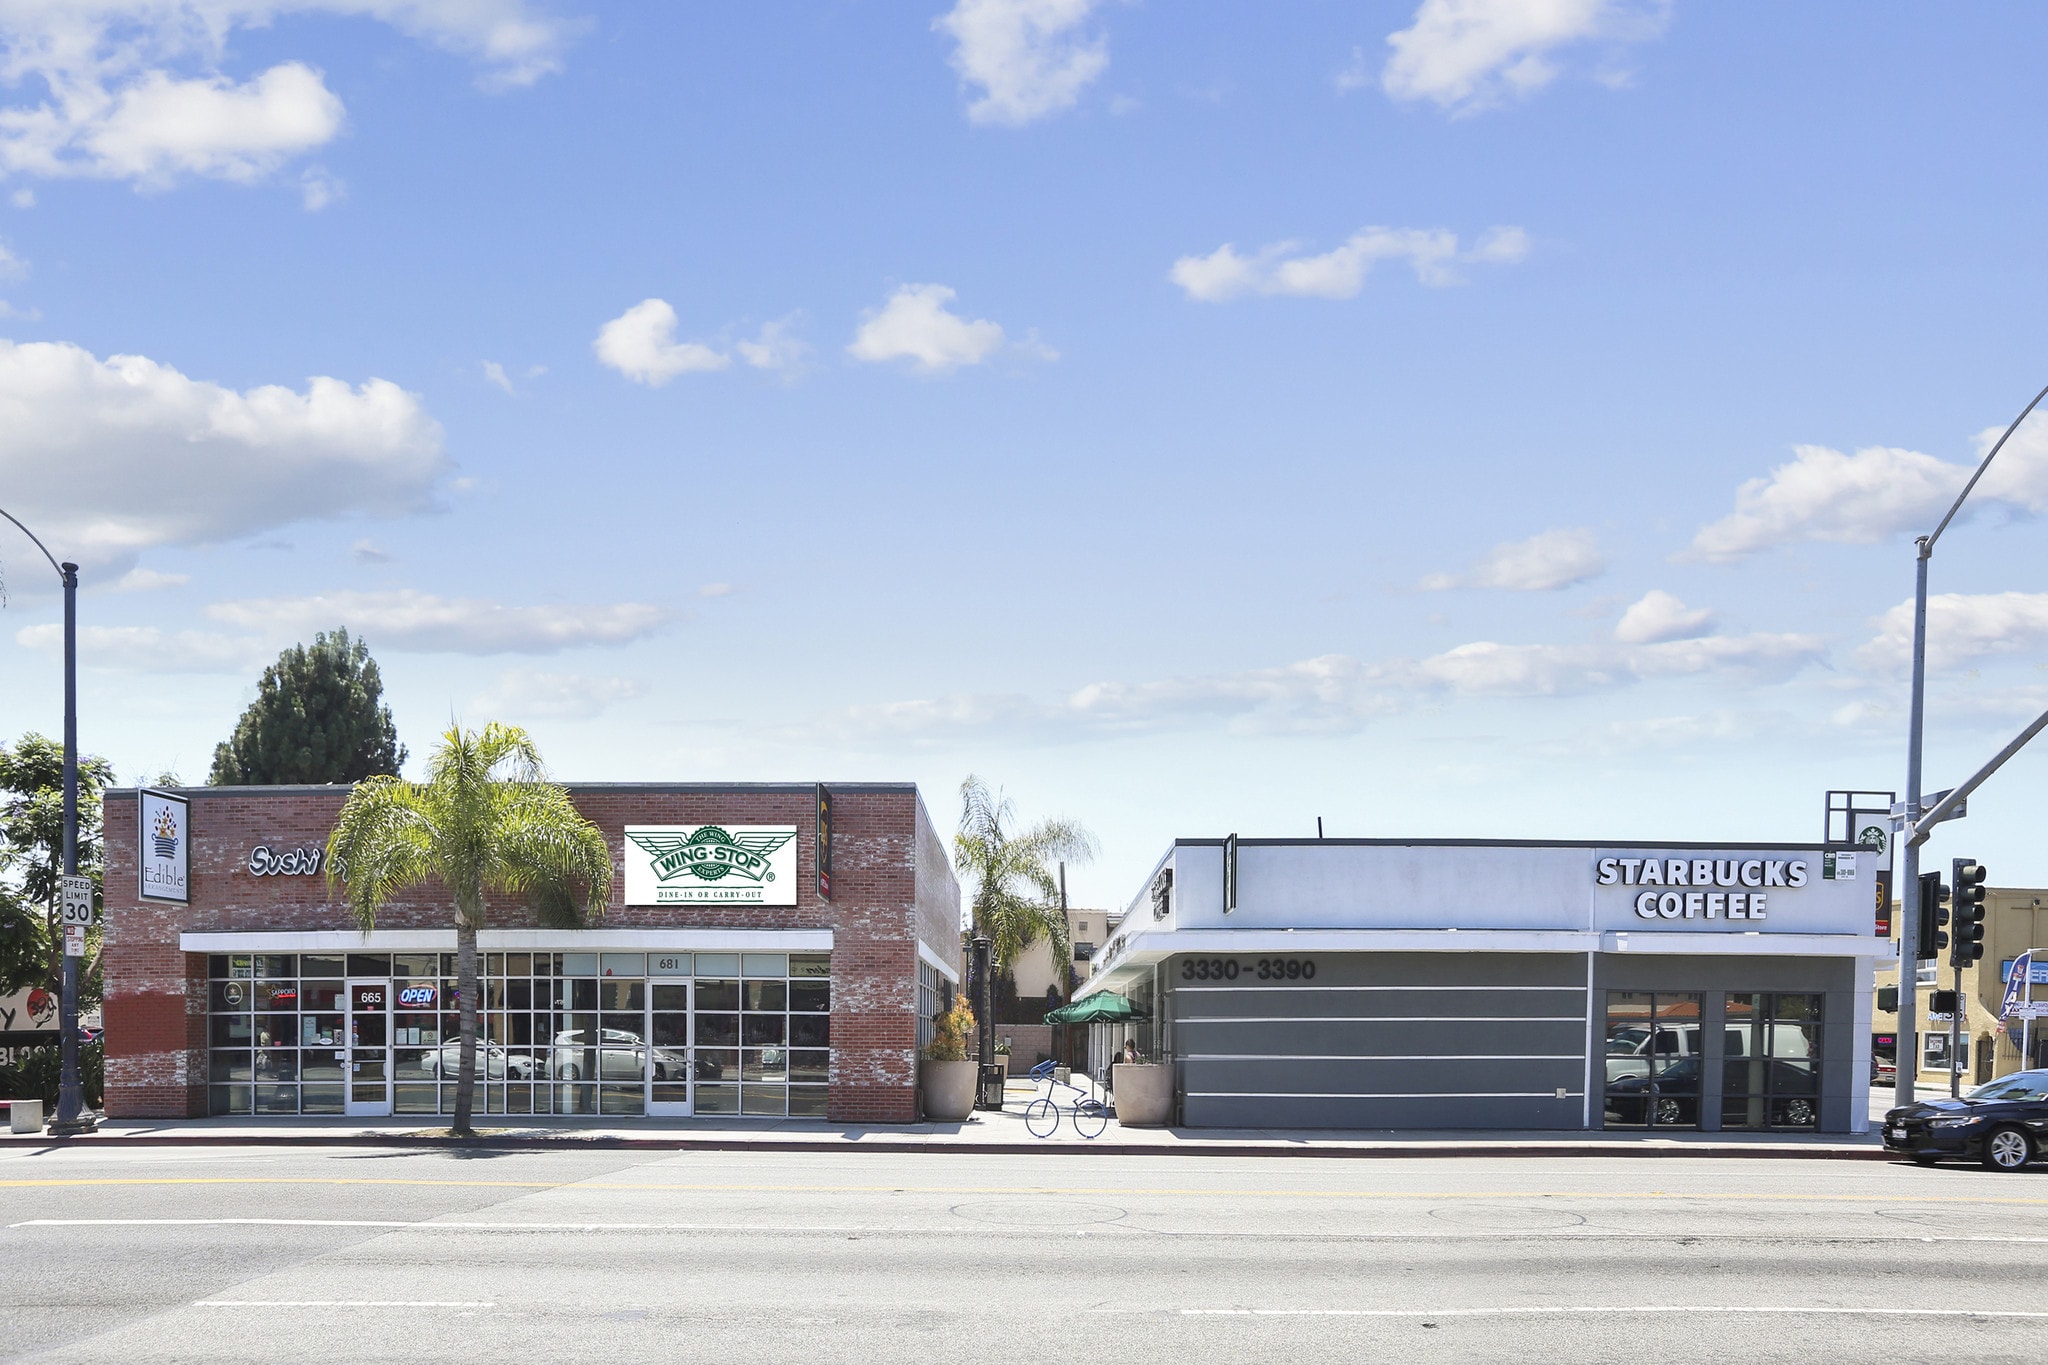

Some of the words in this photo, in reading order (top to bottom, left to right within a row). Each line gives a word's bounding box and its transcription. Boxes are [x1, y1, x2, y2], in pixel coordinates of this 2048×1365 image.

[695, 831, 708, 842] THE
[709, 831, 726, 843] WING
[249, 845, 320, 876] Sushi
[145, 863, 184, 887] Edible
[697, 865, 725, 876] EXPERTS
[1596, 858, 1809, 888] STARBUCKS
[64, 880, 91, 890] SPEED
[66, 891, 88, 900] LIMIT
[1634, 891, 1768, 919] COFFEE
[65, 902, 89, 921] 30
[659, 958, 679, 969] 681
[361, 992, 381, 1003] 665
[400, 989, 429, 1002] OPEN
